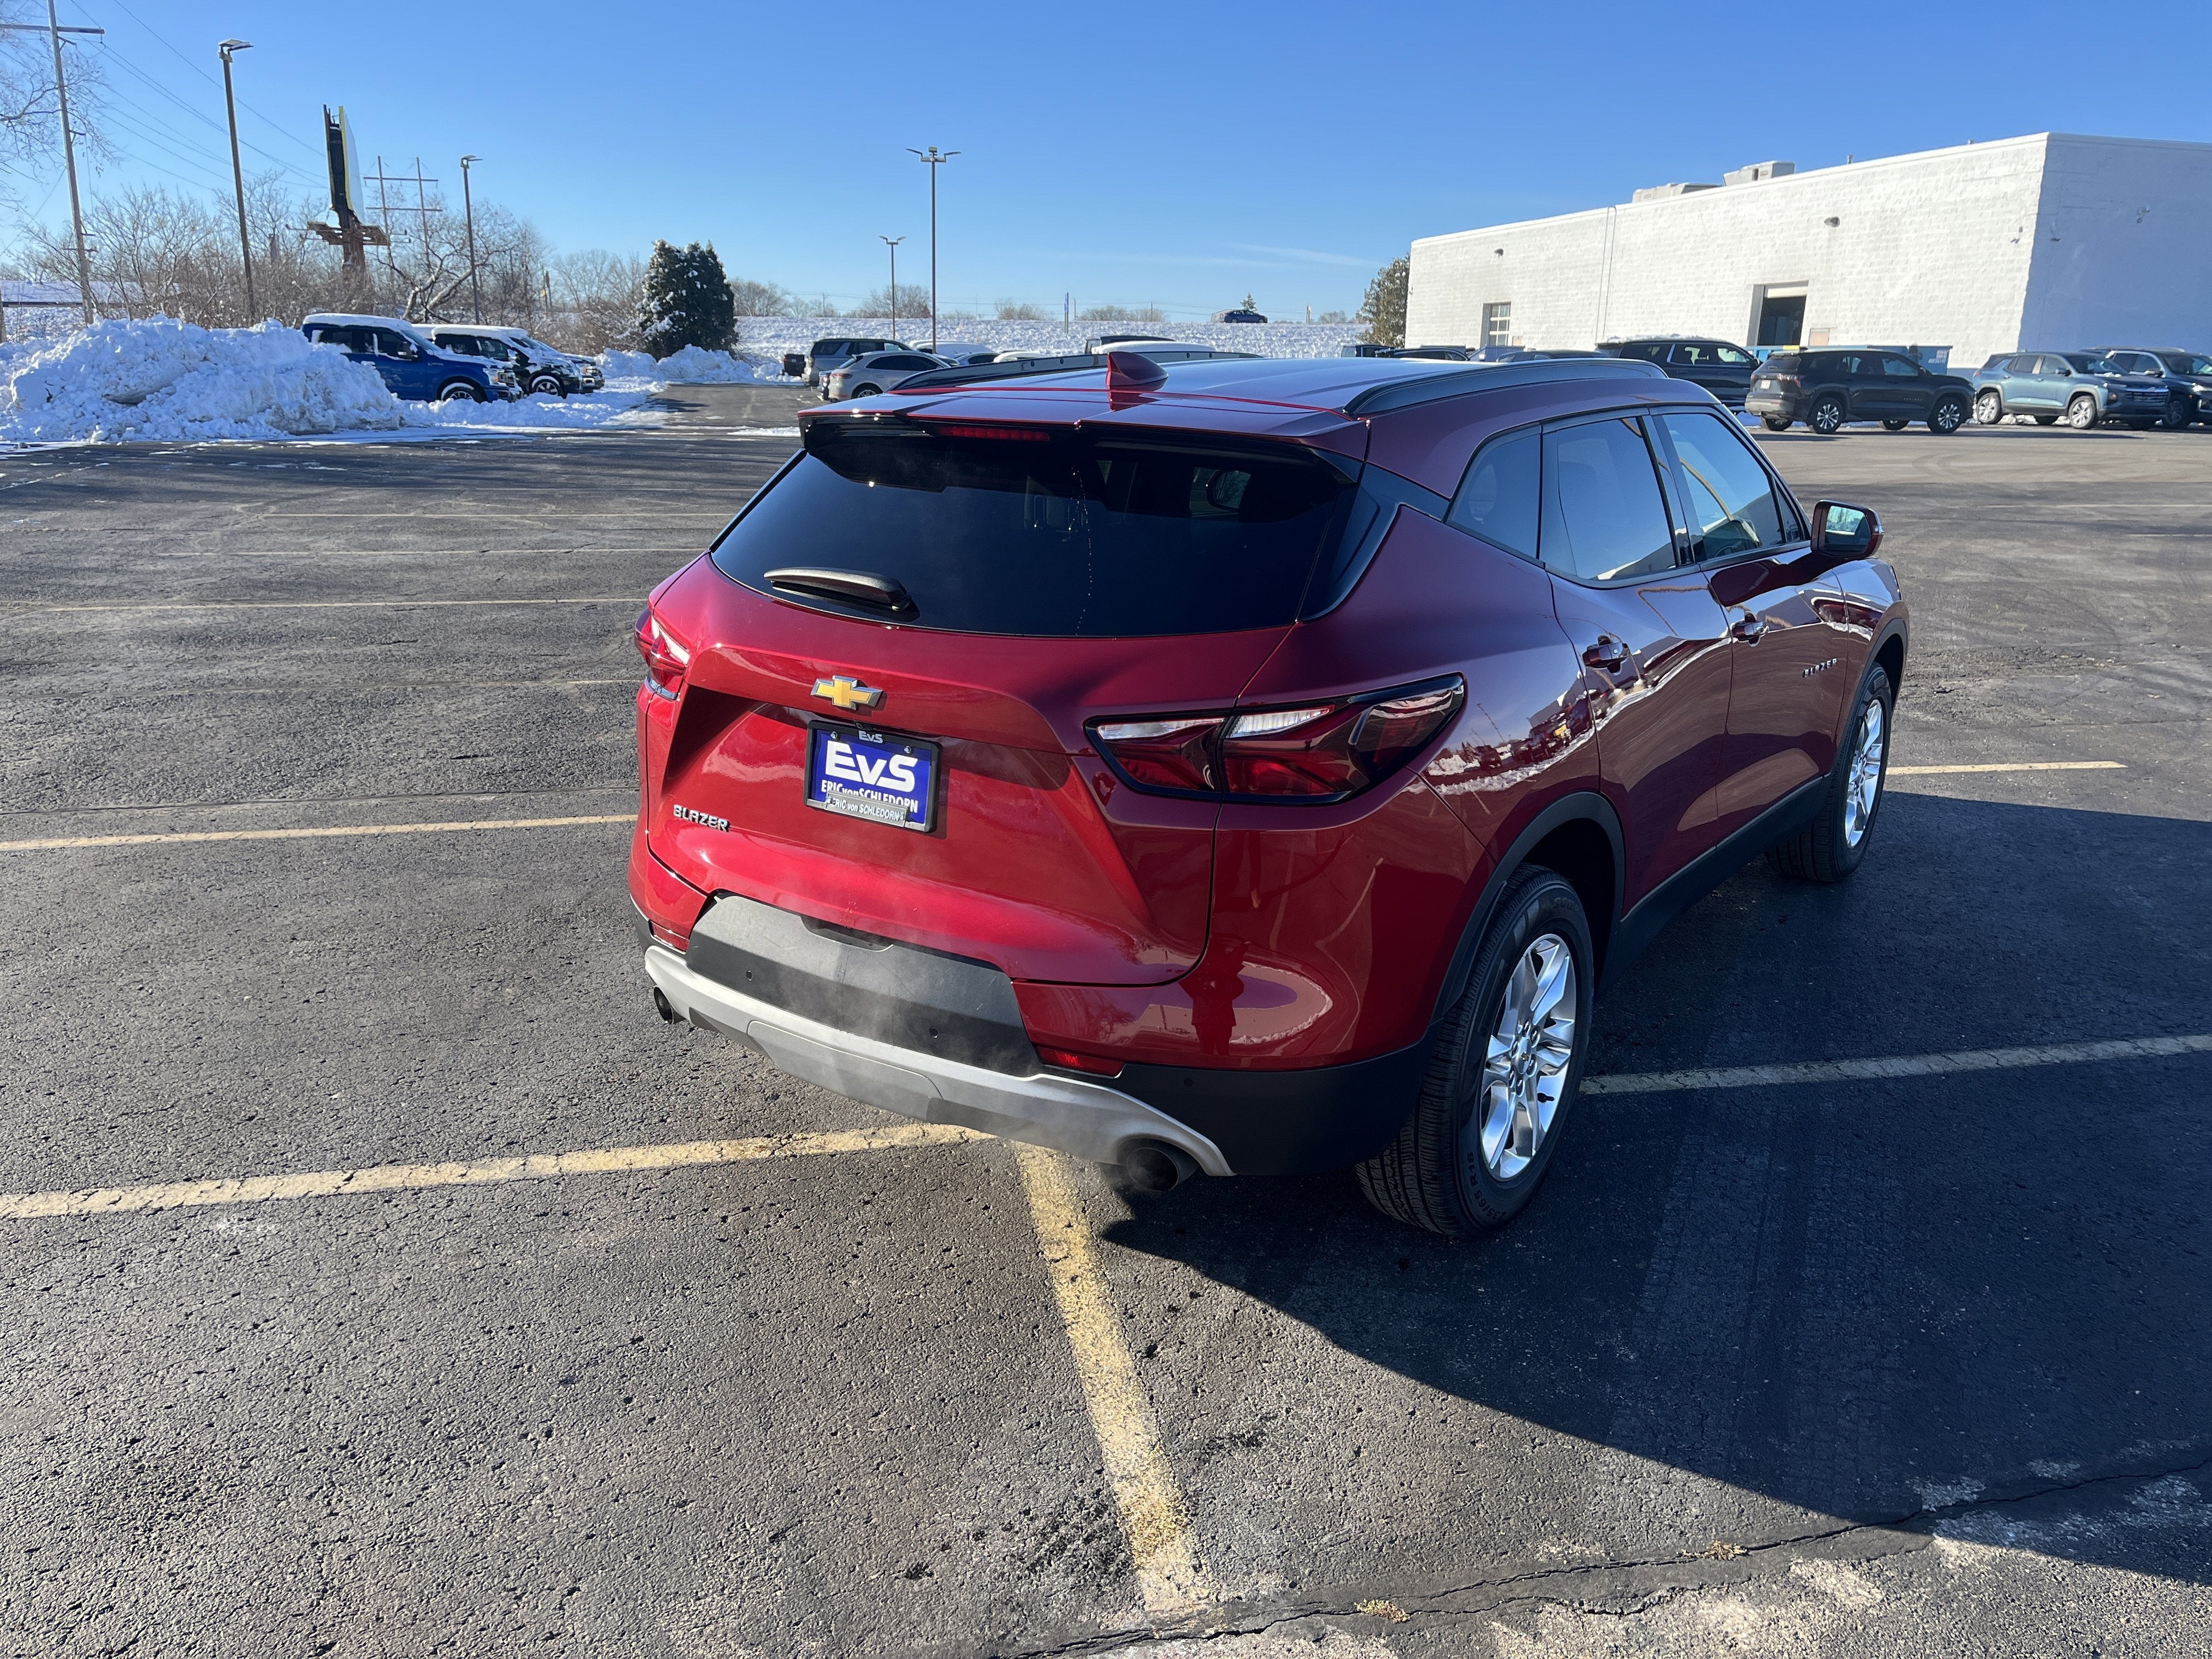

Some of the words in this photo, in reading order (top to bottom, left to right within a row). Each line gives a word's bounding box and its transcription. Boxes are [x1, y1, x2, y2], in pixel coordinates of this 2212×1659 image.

[673, 804, 730, 832] BLAZER
[848, 803, 859, 812] von
[859, 804, 900, 821] SCHLEDORN
